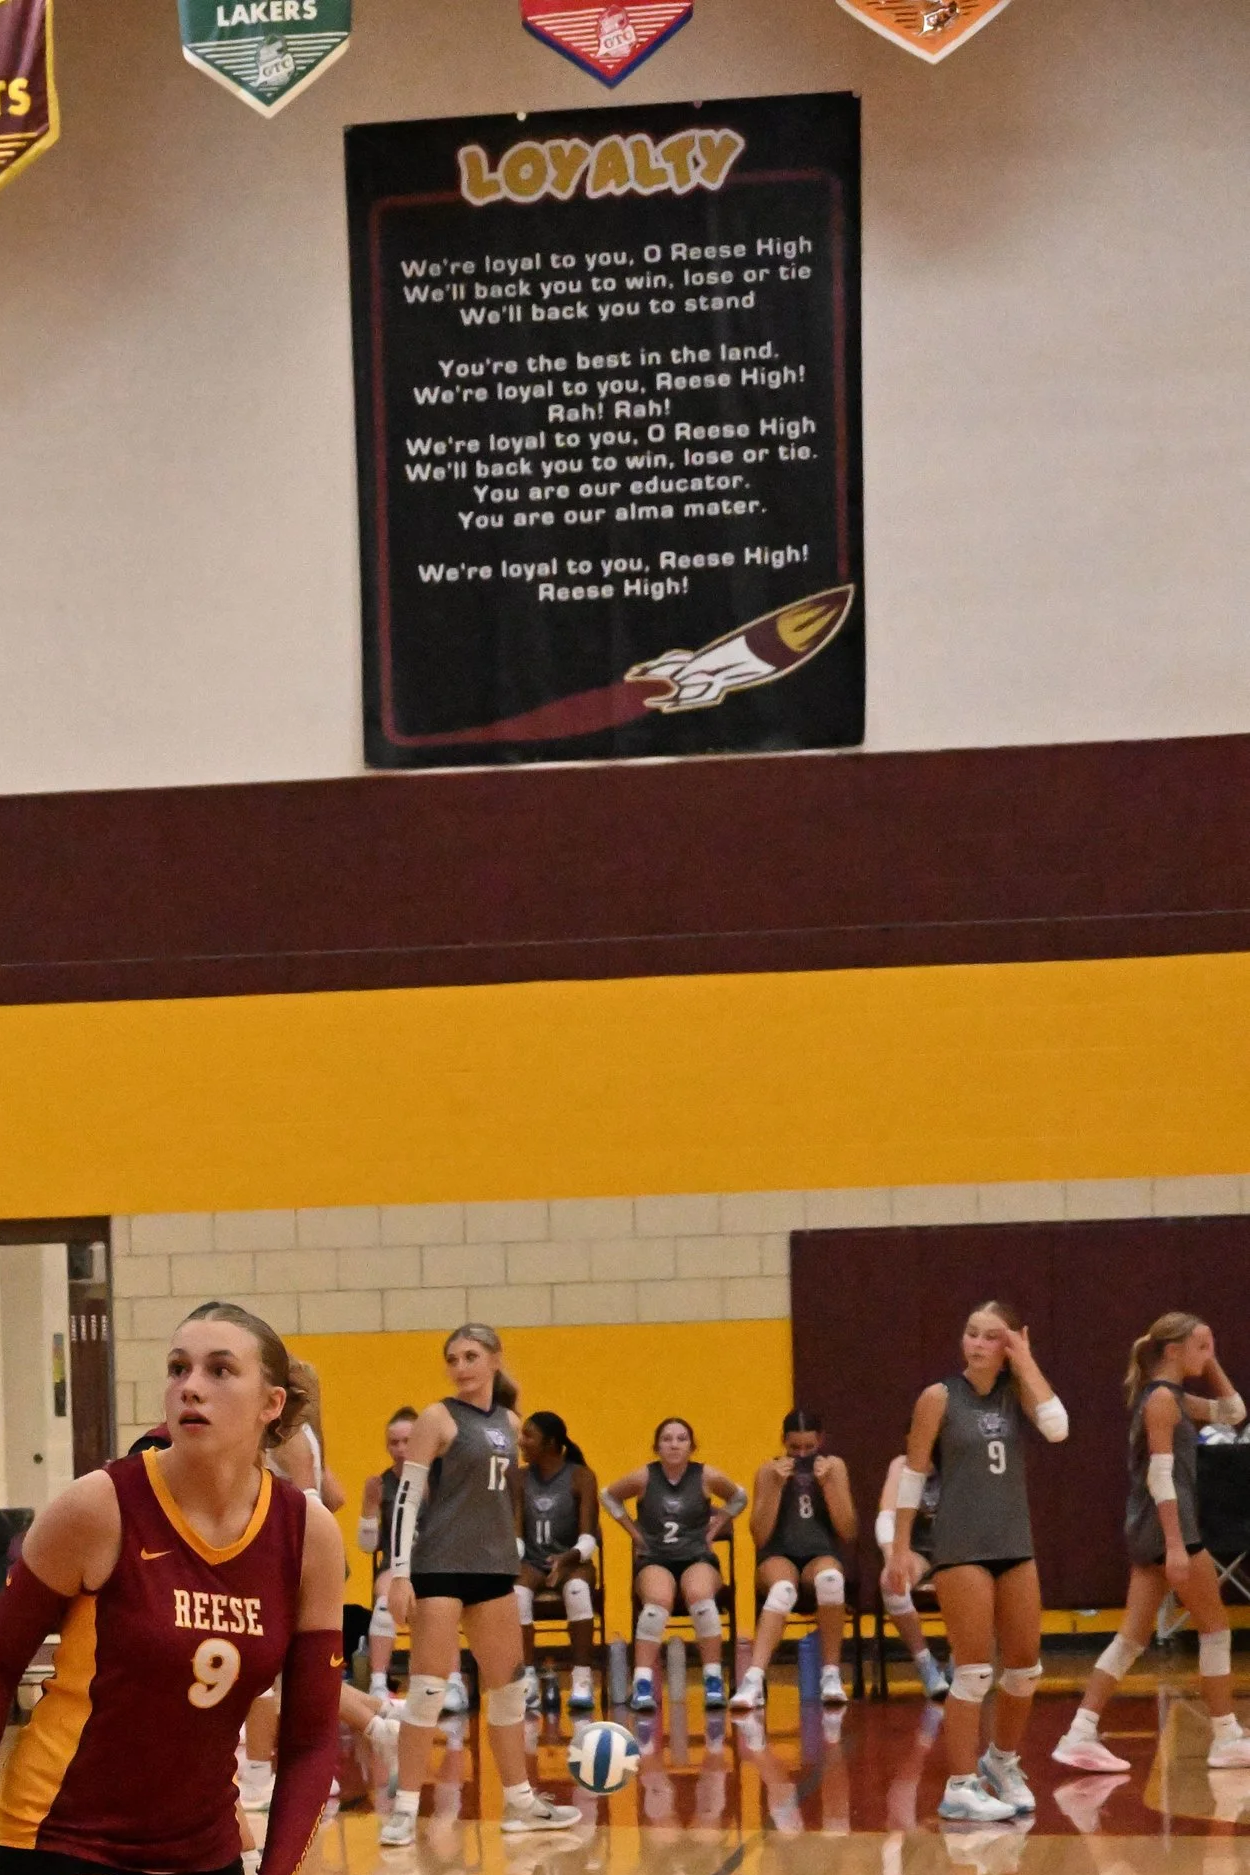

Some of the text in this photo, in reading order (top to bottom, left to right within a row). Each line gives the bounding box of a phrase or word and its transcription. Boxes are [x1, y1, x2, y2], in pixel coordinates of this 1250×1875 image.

[217, 0, 318, 27] LAKERS
[458, 128, 745, 206] LOYALTY
[401, 236, 811, 278] We're loyal to you, O Reese High
[403, 263, 811, 303] We'll back you to win, lose or tie
[460, 291, 755, 326] We'll back you to stand
[438, 341, 779, 378] You're the best in the land.
[413, 365, 805, 405] We're loyal to you, Reese High!
[548, 398, 670, 422] Rah! Rah!
[406, 416, 815, 456] We're loyal to you, O Reese High
[405, 443, 817, 482] We'll back you to win, lose or tie.
[474, 475, 750, 503] You are our educator.
[458, 500, 766, 530] You are our alma mater.
[418, 544, 808, 583] We're loyal to you, Reese High!
[539, 575, 689, 601] Reese High!
[487, 1455, 510, 1491] 17
[988, 1441, 1007, 1474] 9
[799, 1494, 814, 1519] 8
[662, 1520, 679, 1544] 2
[173, 1588, 264, 1636] REESE
[187, 1637, 241, 1709] 9
